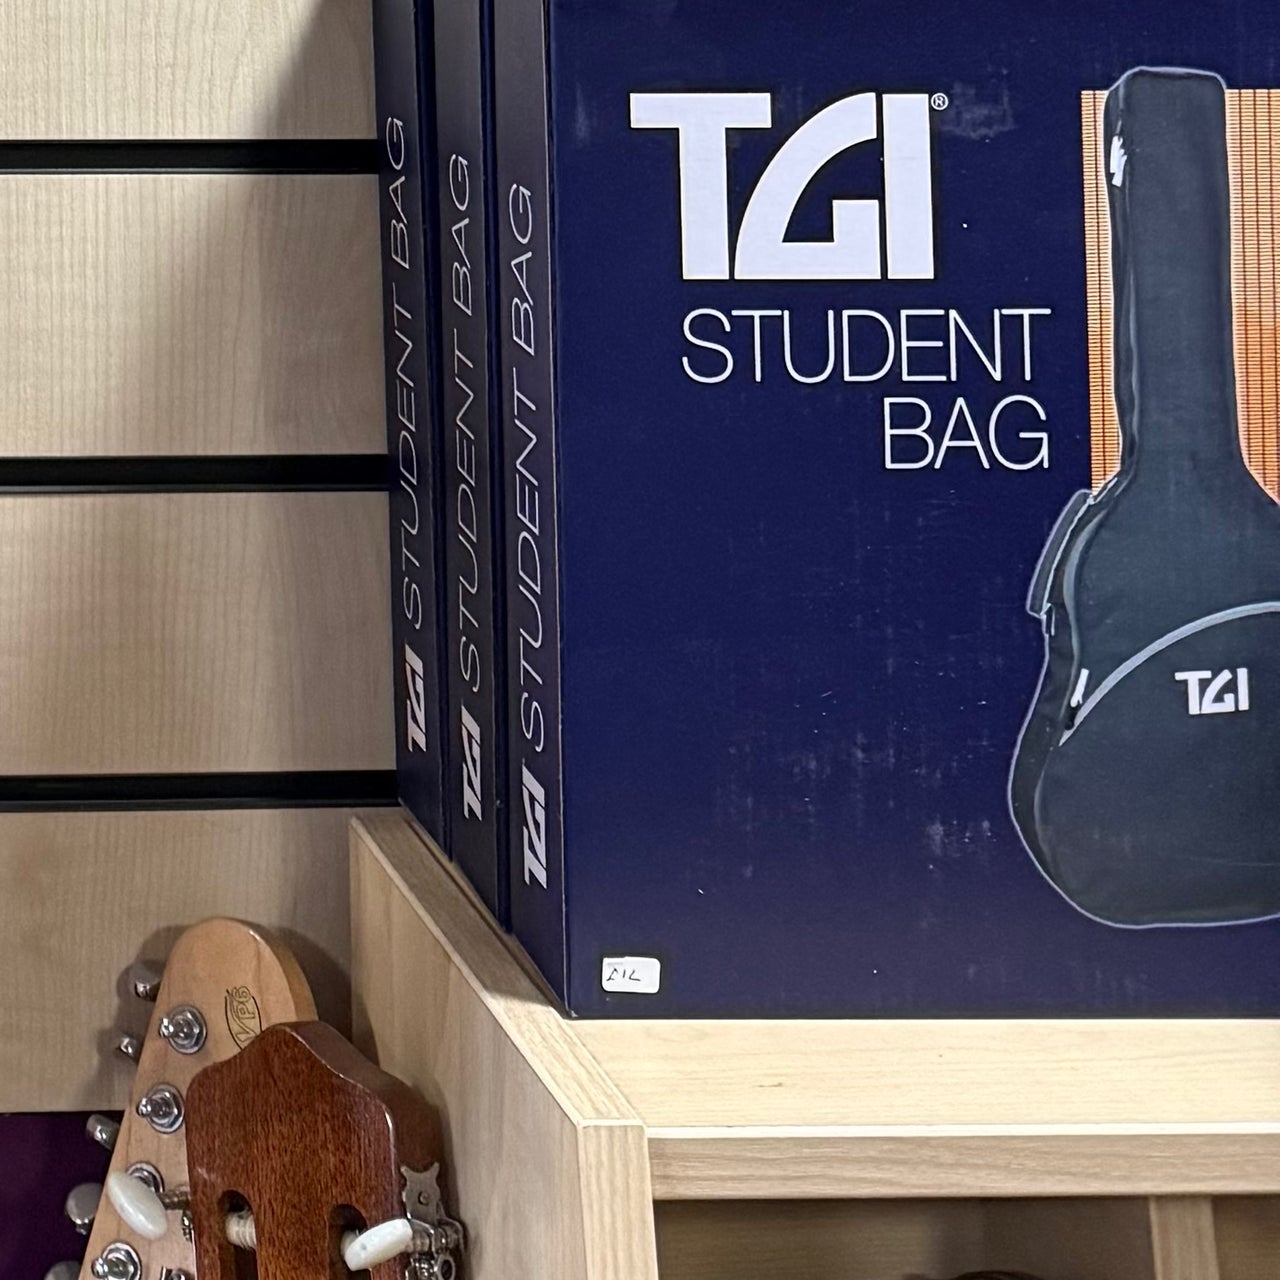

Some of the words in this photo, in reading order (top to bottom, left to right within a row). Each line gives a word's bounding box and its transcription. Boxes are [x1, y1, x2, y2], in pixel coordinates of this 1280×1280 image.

[382, 115, 411, 272] BAG
[447, 152, 473, 316] BAG
[629, 92, 935, 280] TGI
[507, 183, 536, 357] BAG
[681, 307, 1051, 384] STUDENT
[393, 281, 424, 633] STUDENT
[452, 324, 482, 695] STUDENT
[883, 395, 1049, 471] BAG
[512, 366, 546, 755] STUDENT
[404, 642, 429, 754] TGI
[459, 704, 485, 822] TGI
[1174, 667, 1250, 716] TGI
[519, 755, 548, 891] TGI
